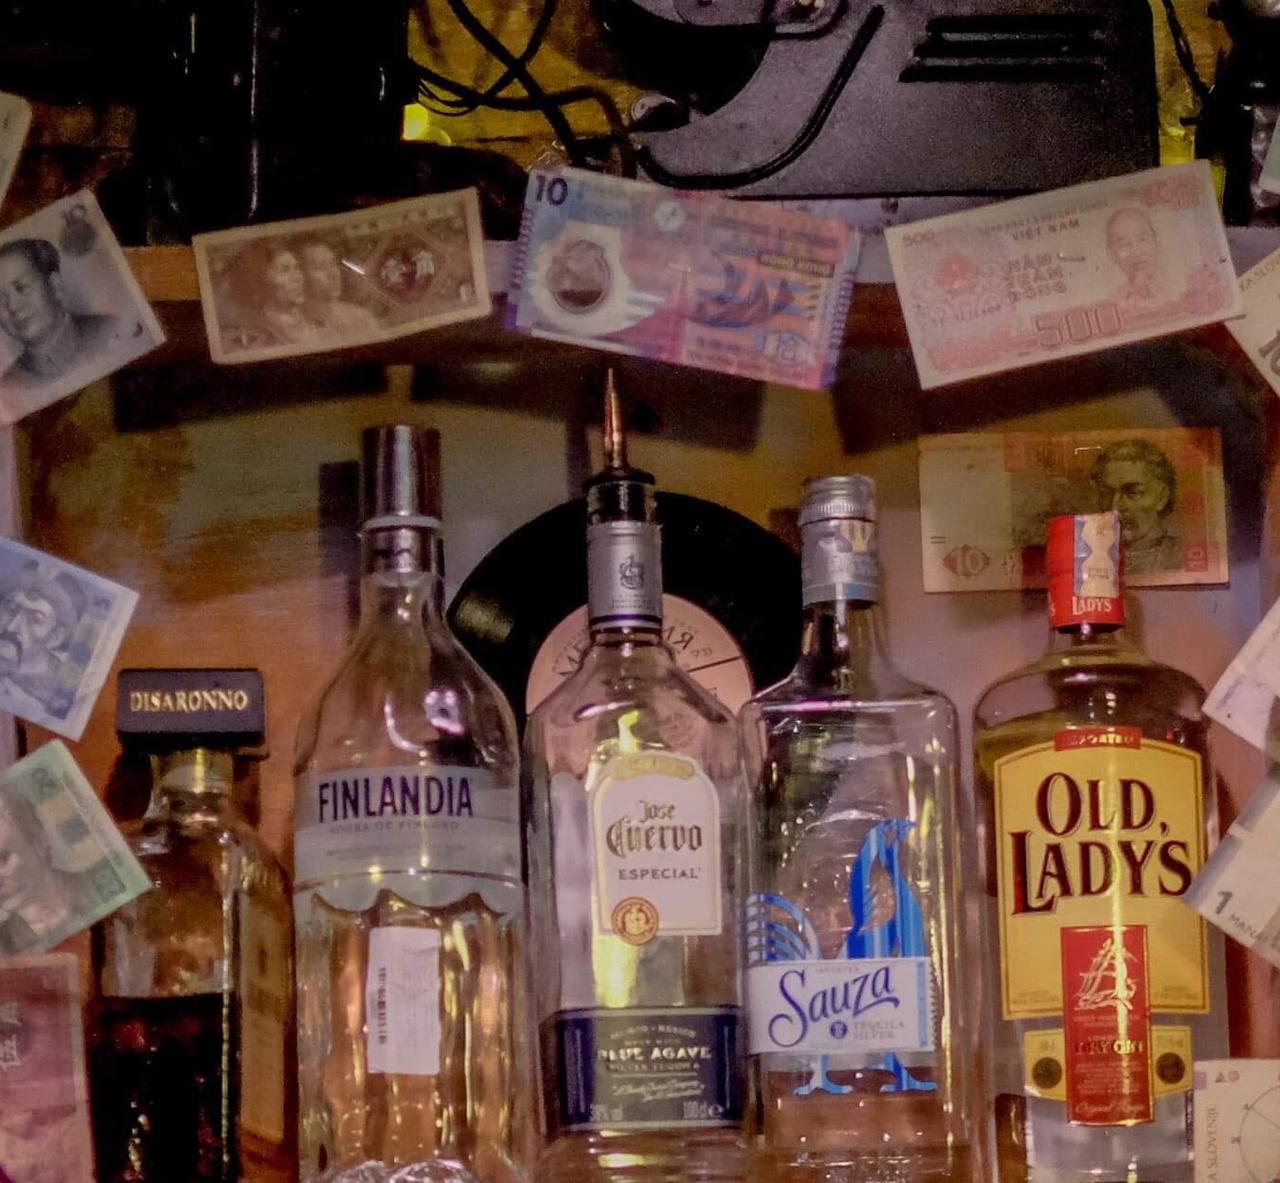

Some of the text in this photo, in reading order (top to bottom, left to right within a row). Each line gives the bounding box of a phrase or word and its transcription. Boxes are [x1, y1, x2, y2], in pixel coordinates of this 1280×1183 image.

[535, 175, 569, 206] 10
[1031, 302, 1120, 350] 500
[130, 688, 248, 714] DISARONNO
[318, 775, 475, 824] FINLANDIA
[1035, 771, 1155, 837] OLD
[606, 815, 703, 859] Cuervo
[618, 868, 700, 881] ESPECIAL
[1010, 822, 1193, 916] LADY'S
[769, 965, 901, 1048] Sauza
[650, 1045, 712, 1061] AGAVE
